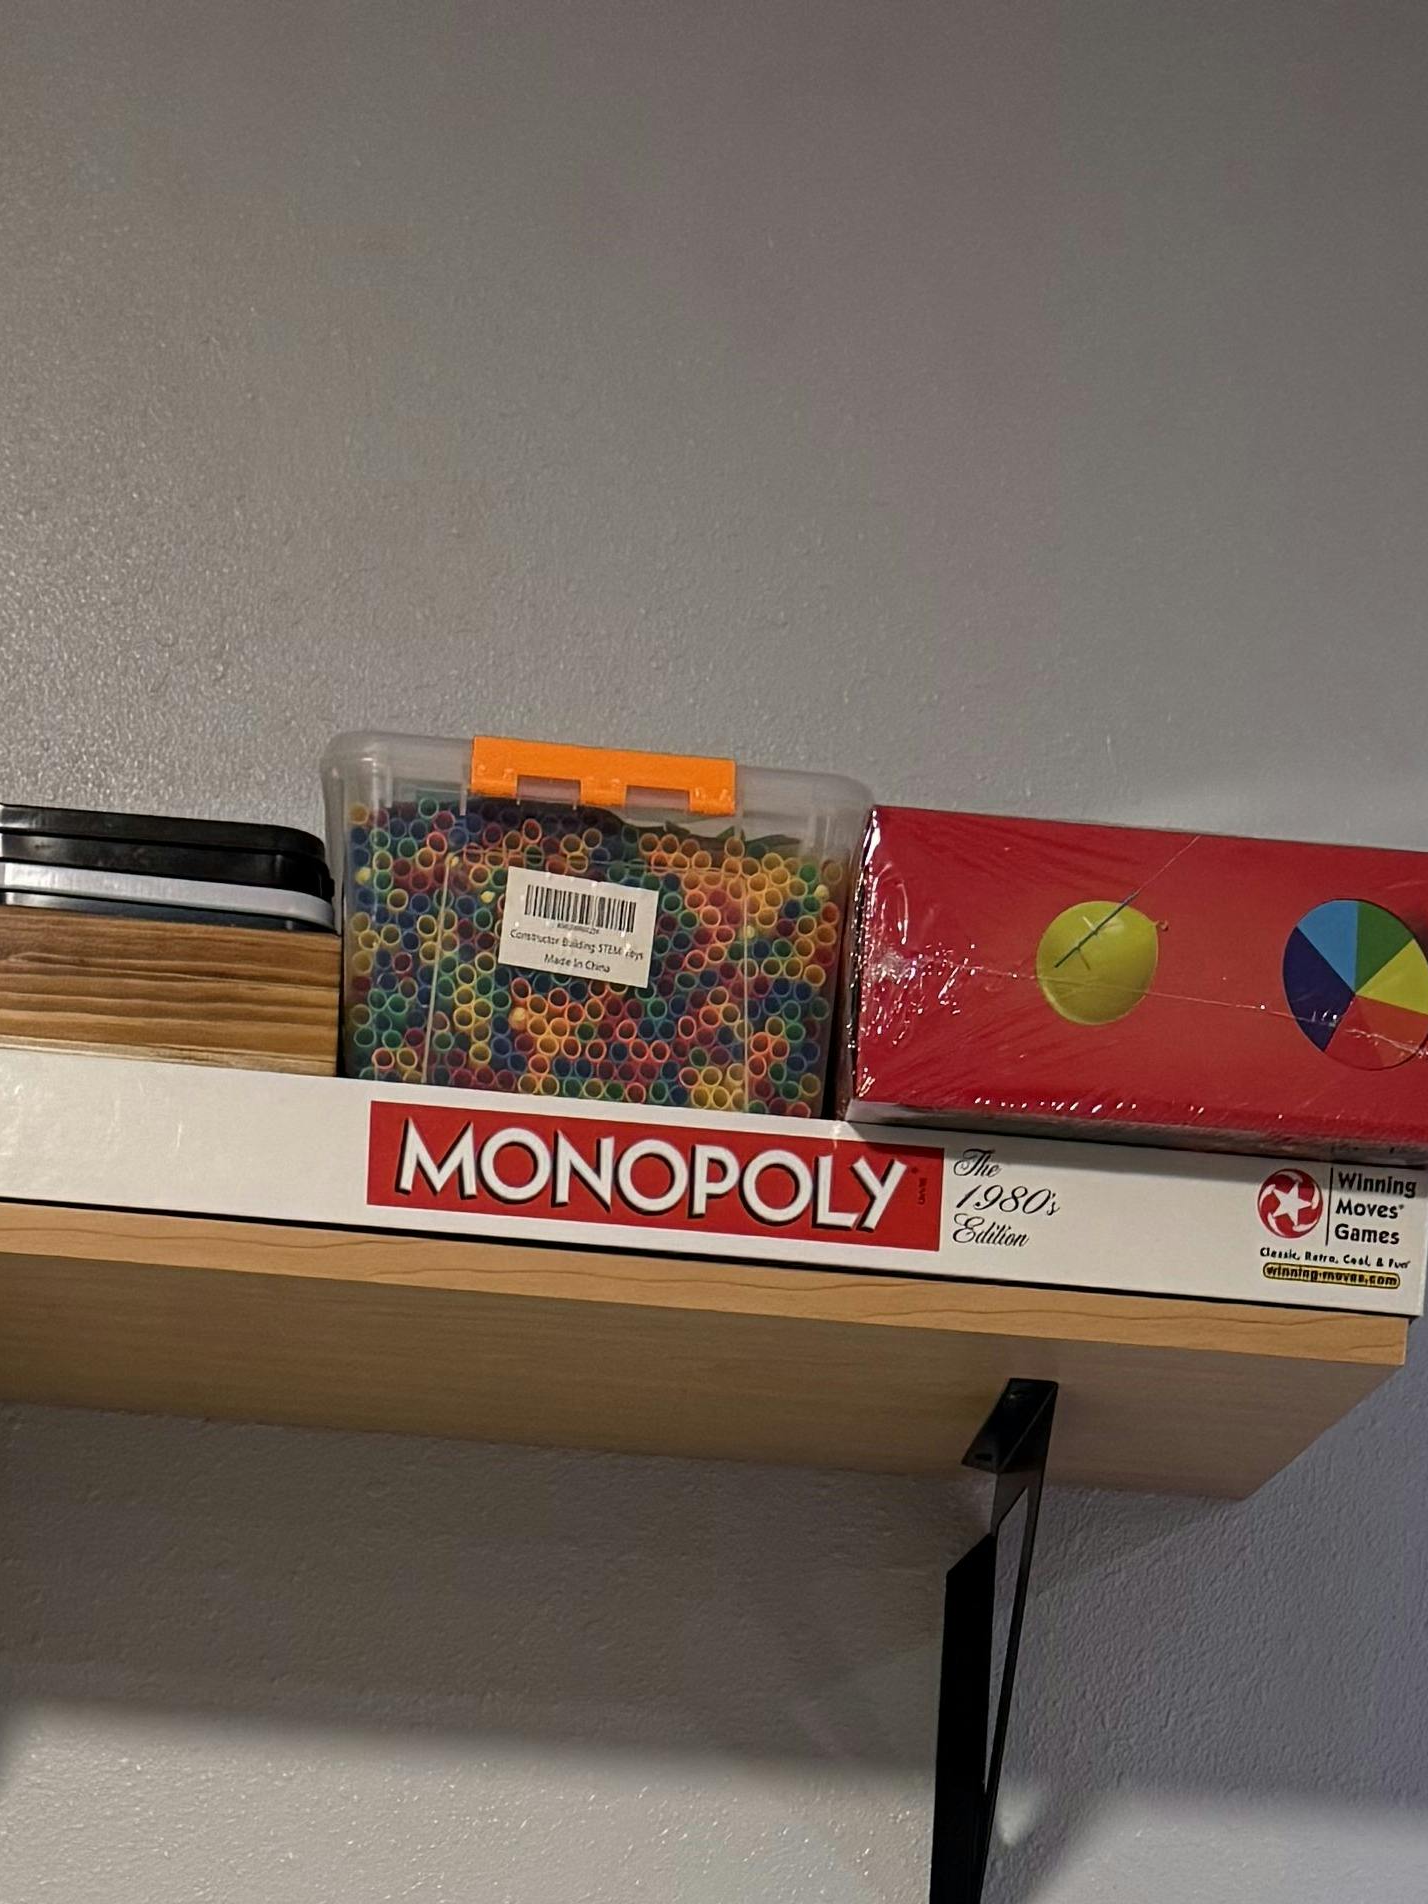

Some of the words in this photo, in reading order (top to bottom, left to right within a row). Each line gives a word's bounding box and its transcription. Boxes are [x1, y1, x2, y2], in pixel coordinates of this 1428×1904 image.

[397, 1115, 908, 1231] MONOPOLY
[953, 1148, 1001, 1178] The
[956, 1184, 1060, 1216] 1980's
[1338, 1171, 1417, 1199] Winning
[952, 1213, 1029, 1247] Edition
[1334, 1223, 1400, 1245] Games
